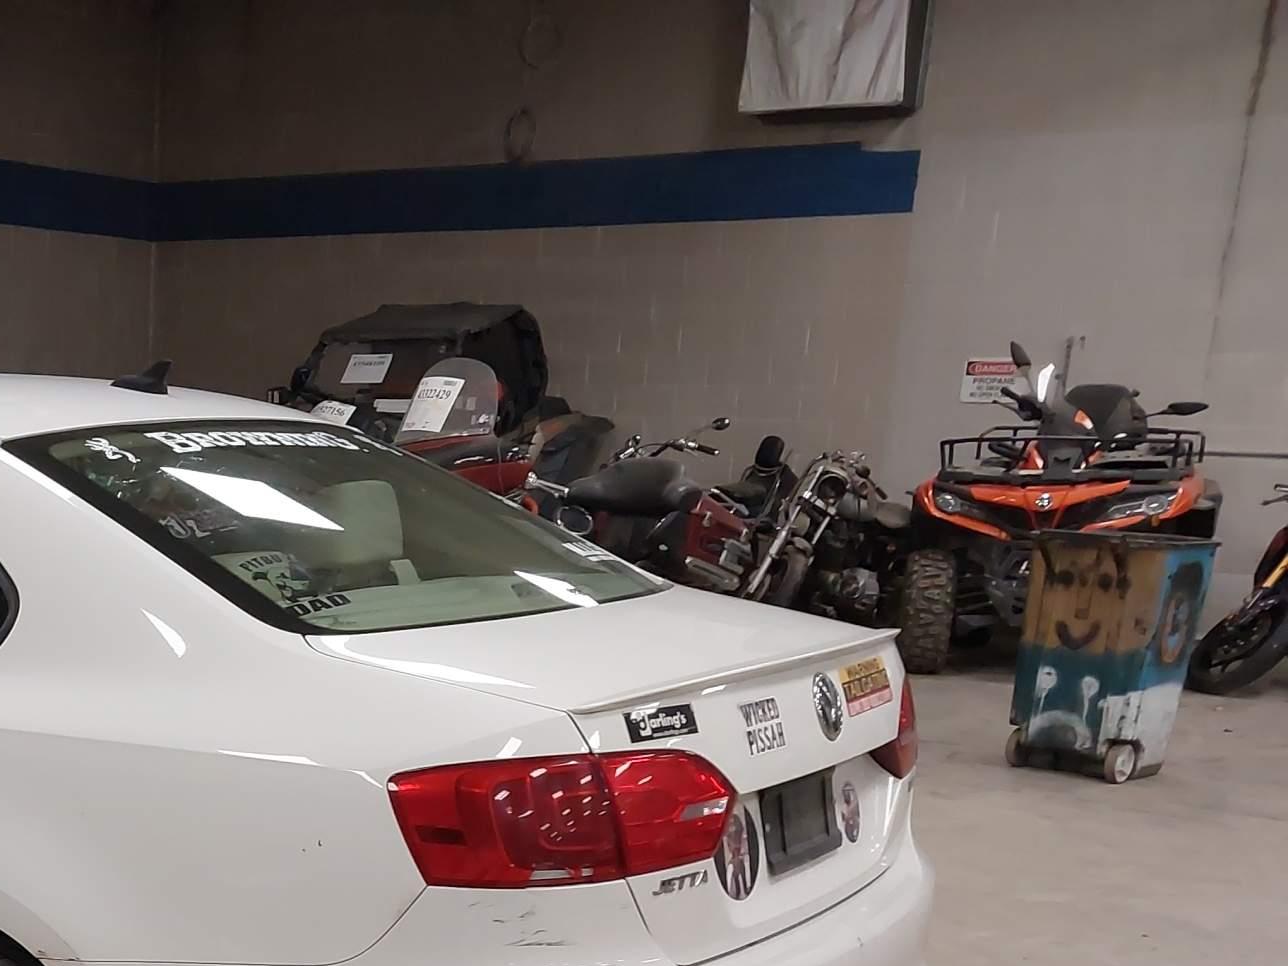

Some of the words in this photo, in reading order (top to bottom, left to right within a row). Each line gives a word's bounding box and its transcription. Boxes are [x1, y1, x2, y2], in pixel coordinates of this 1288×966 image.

[972, 376, 1016, 385] PROPANE
[239, 553, 284, 572] PITBU
[287, 594, 351, 616] DAD
[739, 697, 781, 728] WICKED
[746, 722, 787, 756] PISSAH
[652, 869, 708, 896] JETTA
